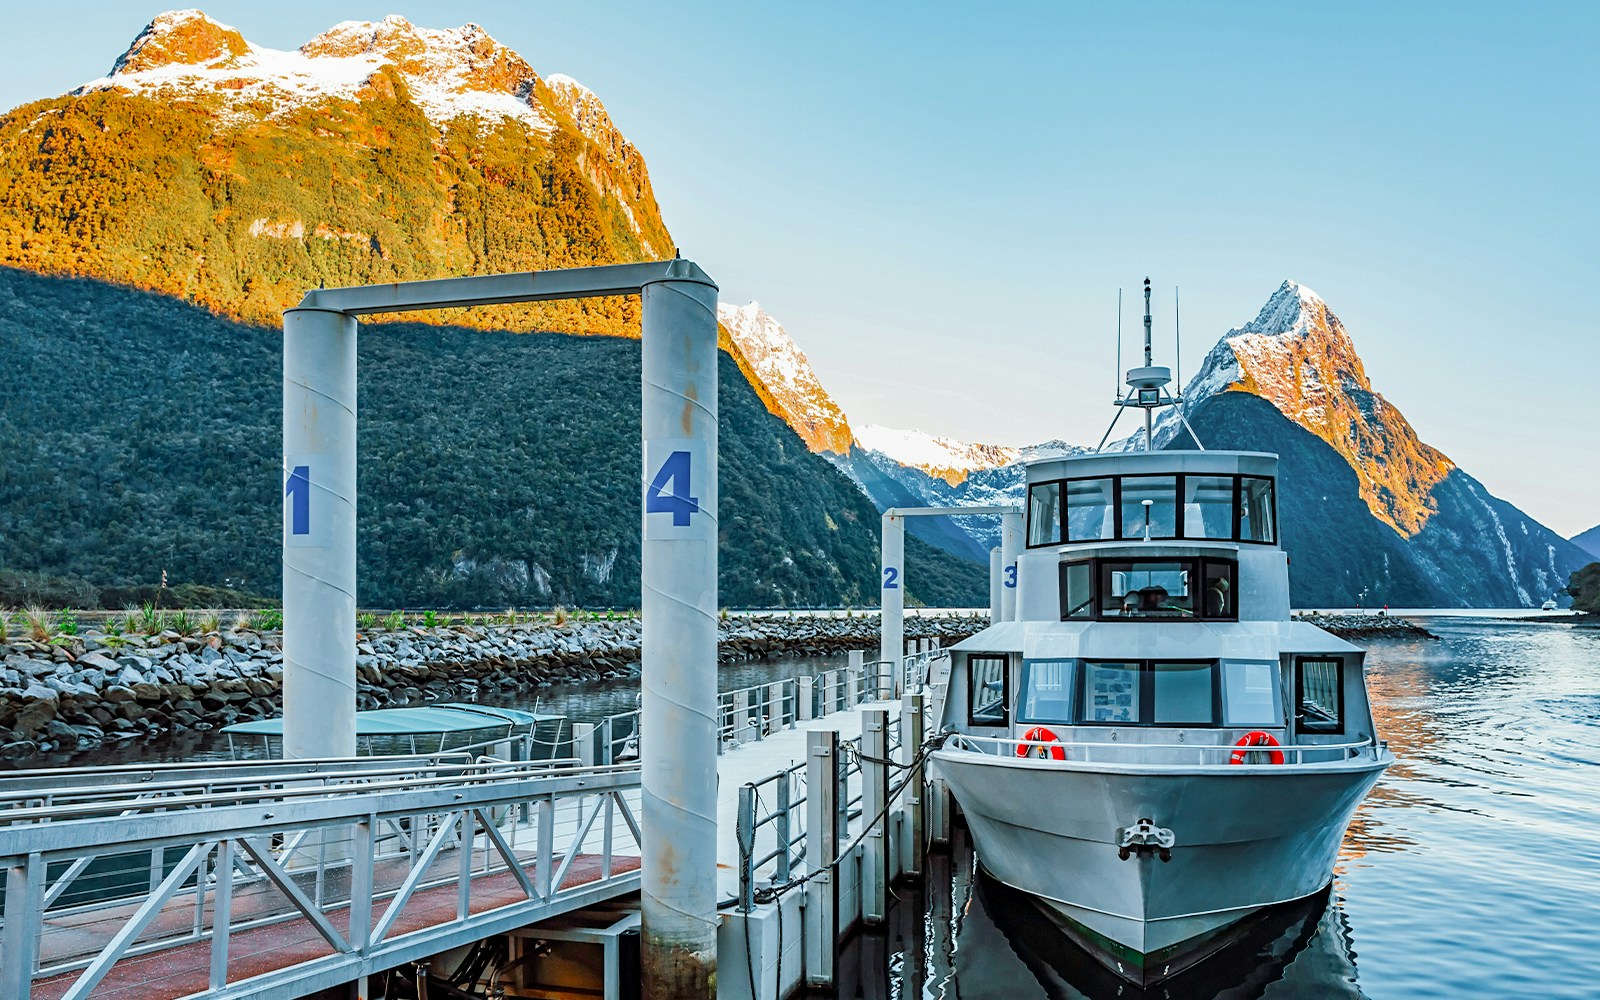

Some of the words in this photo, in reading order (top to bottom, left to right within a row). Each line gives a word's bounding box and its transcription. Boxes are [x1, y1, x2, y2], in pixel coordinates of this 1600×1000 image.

[286, 466, 310, 535] 1
[646, 451, 699, 527] 4
[883, 567, 898, 589] 2
[1004, 565, 1017, 588] 3
